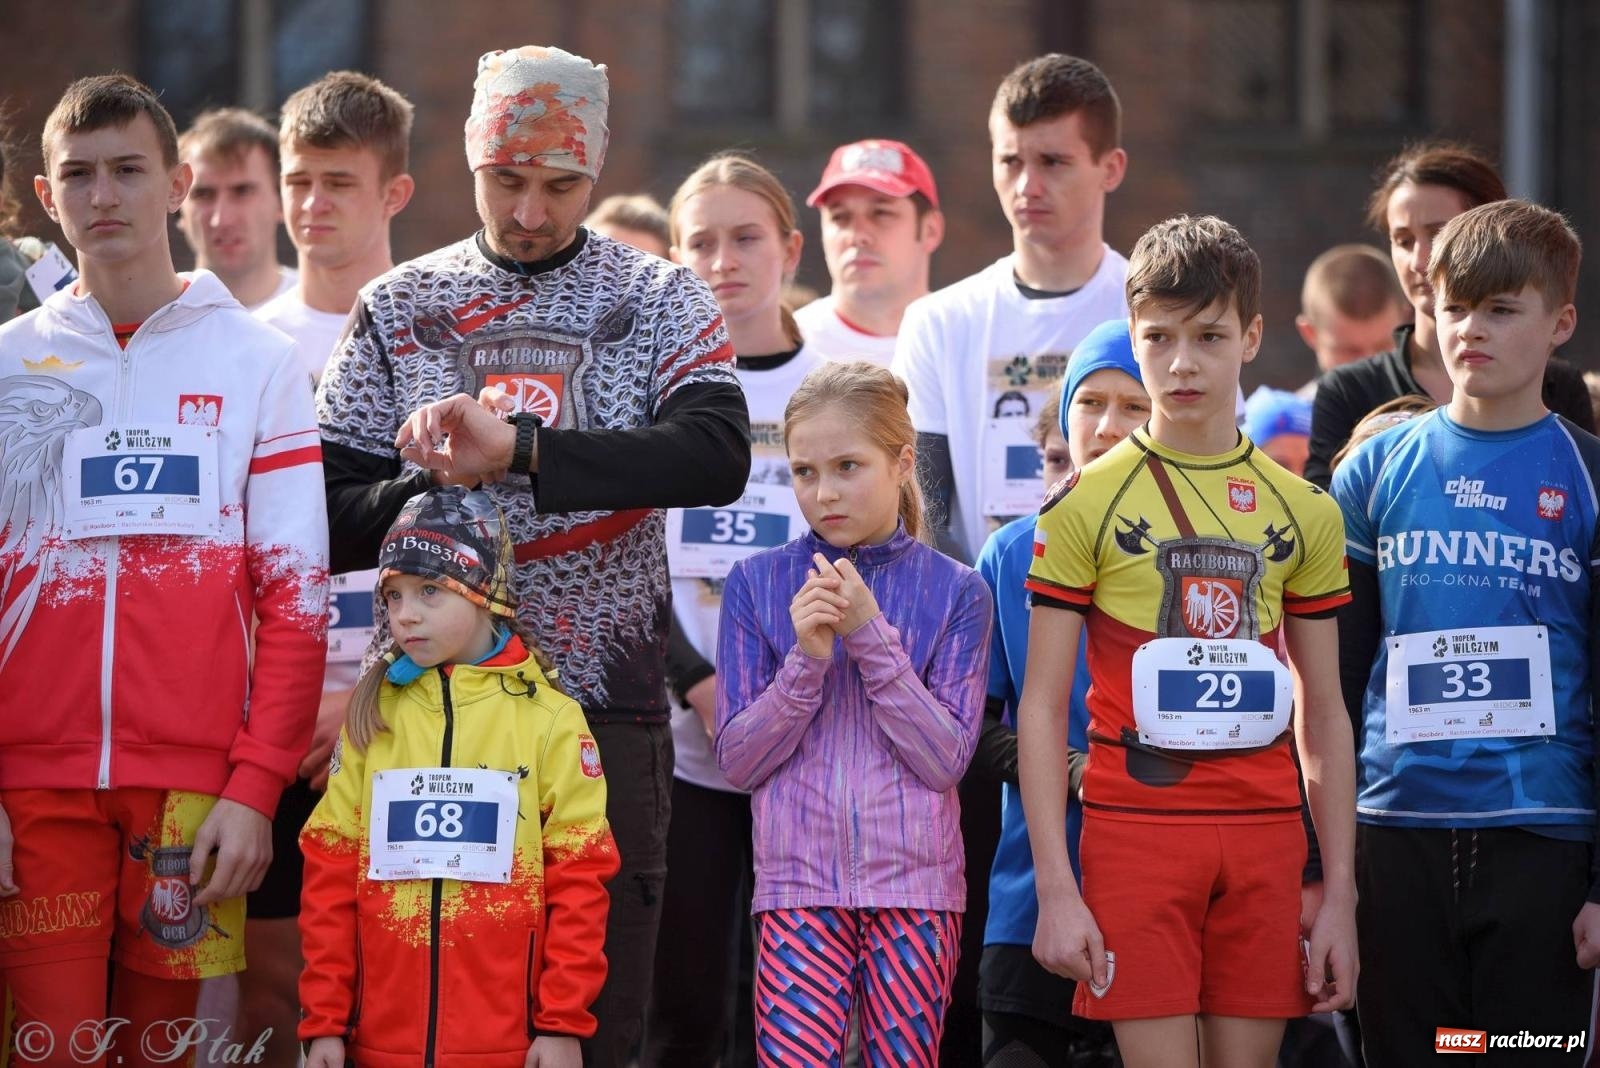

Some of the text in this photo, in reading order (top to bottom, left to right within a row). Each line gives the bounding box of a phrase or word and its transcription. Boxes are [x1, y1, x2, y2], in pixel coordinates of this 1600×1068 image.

[126, 437, 172, 448] WILCZYM
[114, 456, 164, 491] 67
[710, 511, 756, 544] 35
[1377, 530, 1582, 583] RUNNERS
[1498, 576, 1541, 598] TEAM
[1452, 634, 1476, 642] TROPEM
[1453, 641, 1499, 654] WILCZYM
[1208, 652, 1248, 664] WILCZYM
[1196, 673, 1242, 709] 29
[1442, 662, 1492, 699] 33
[428, 782, 474, 794] WILCZYM
[414, 802, 463, 838] 68
[162, 926, 187, 940] OCR
